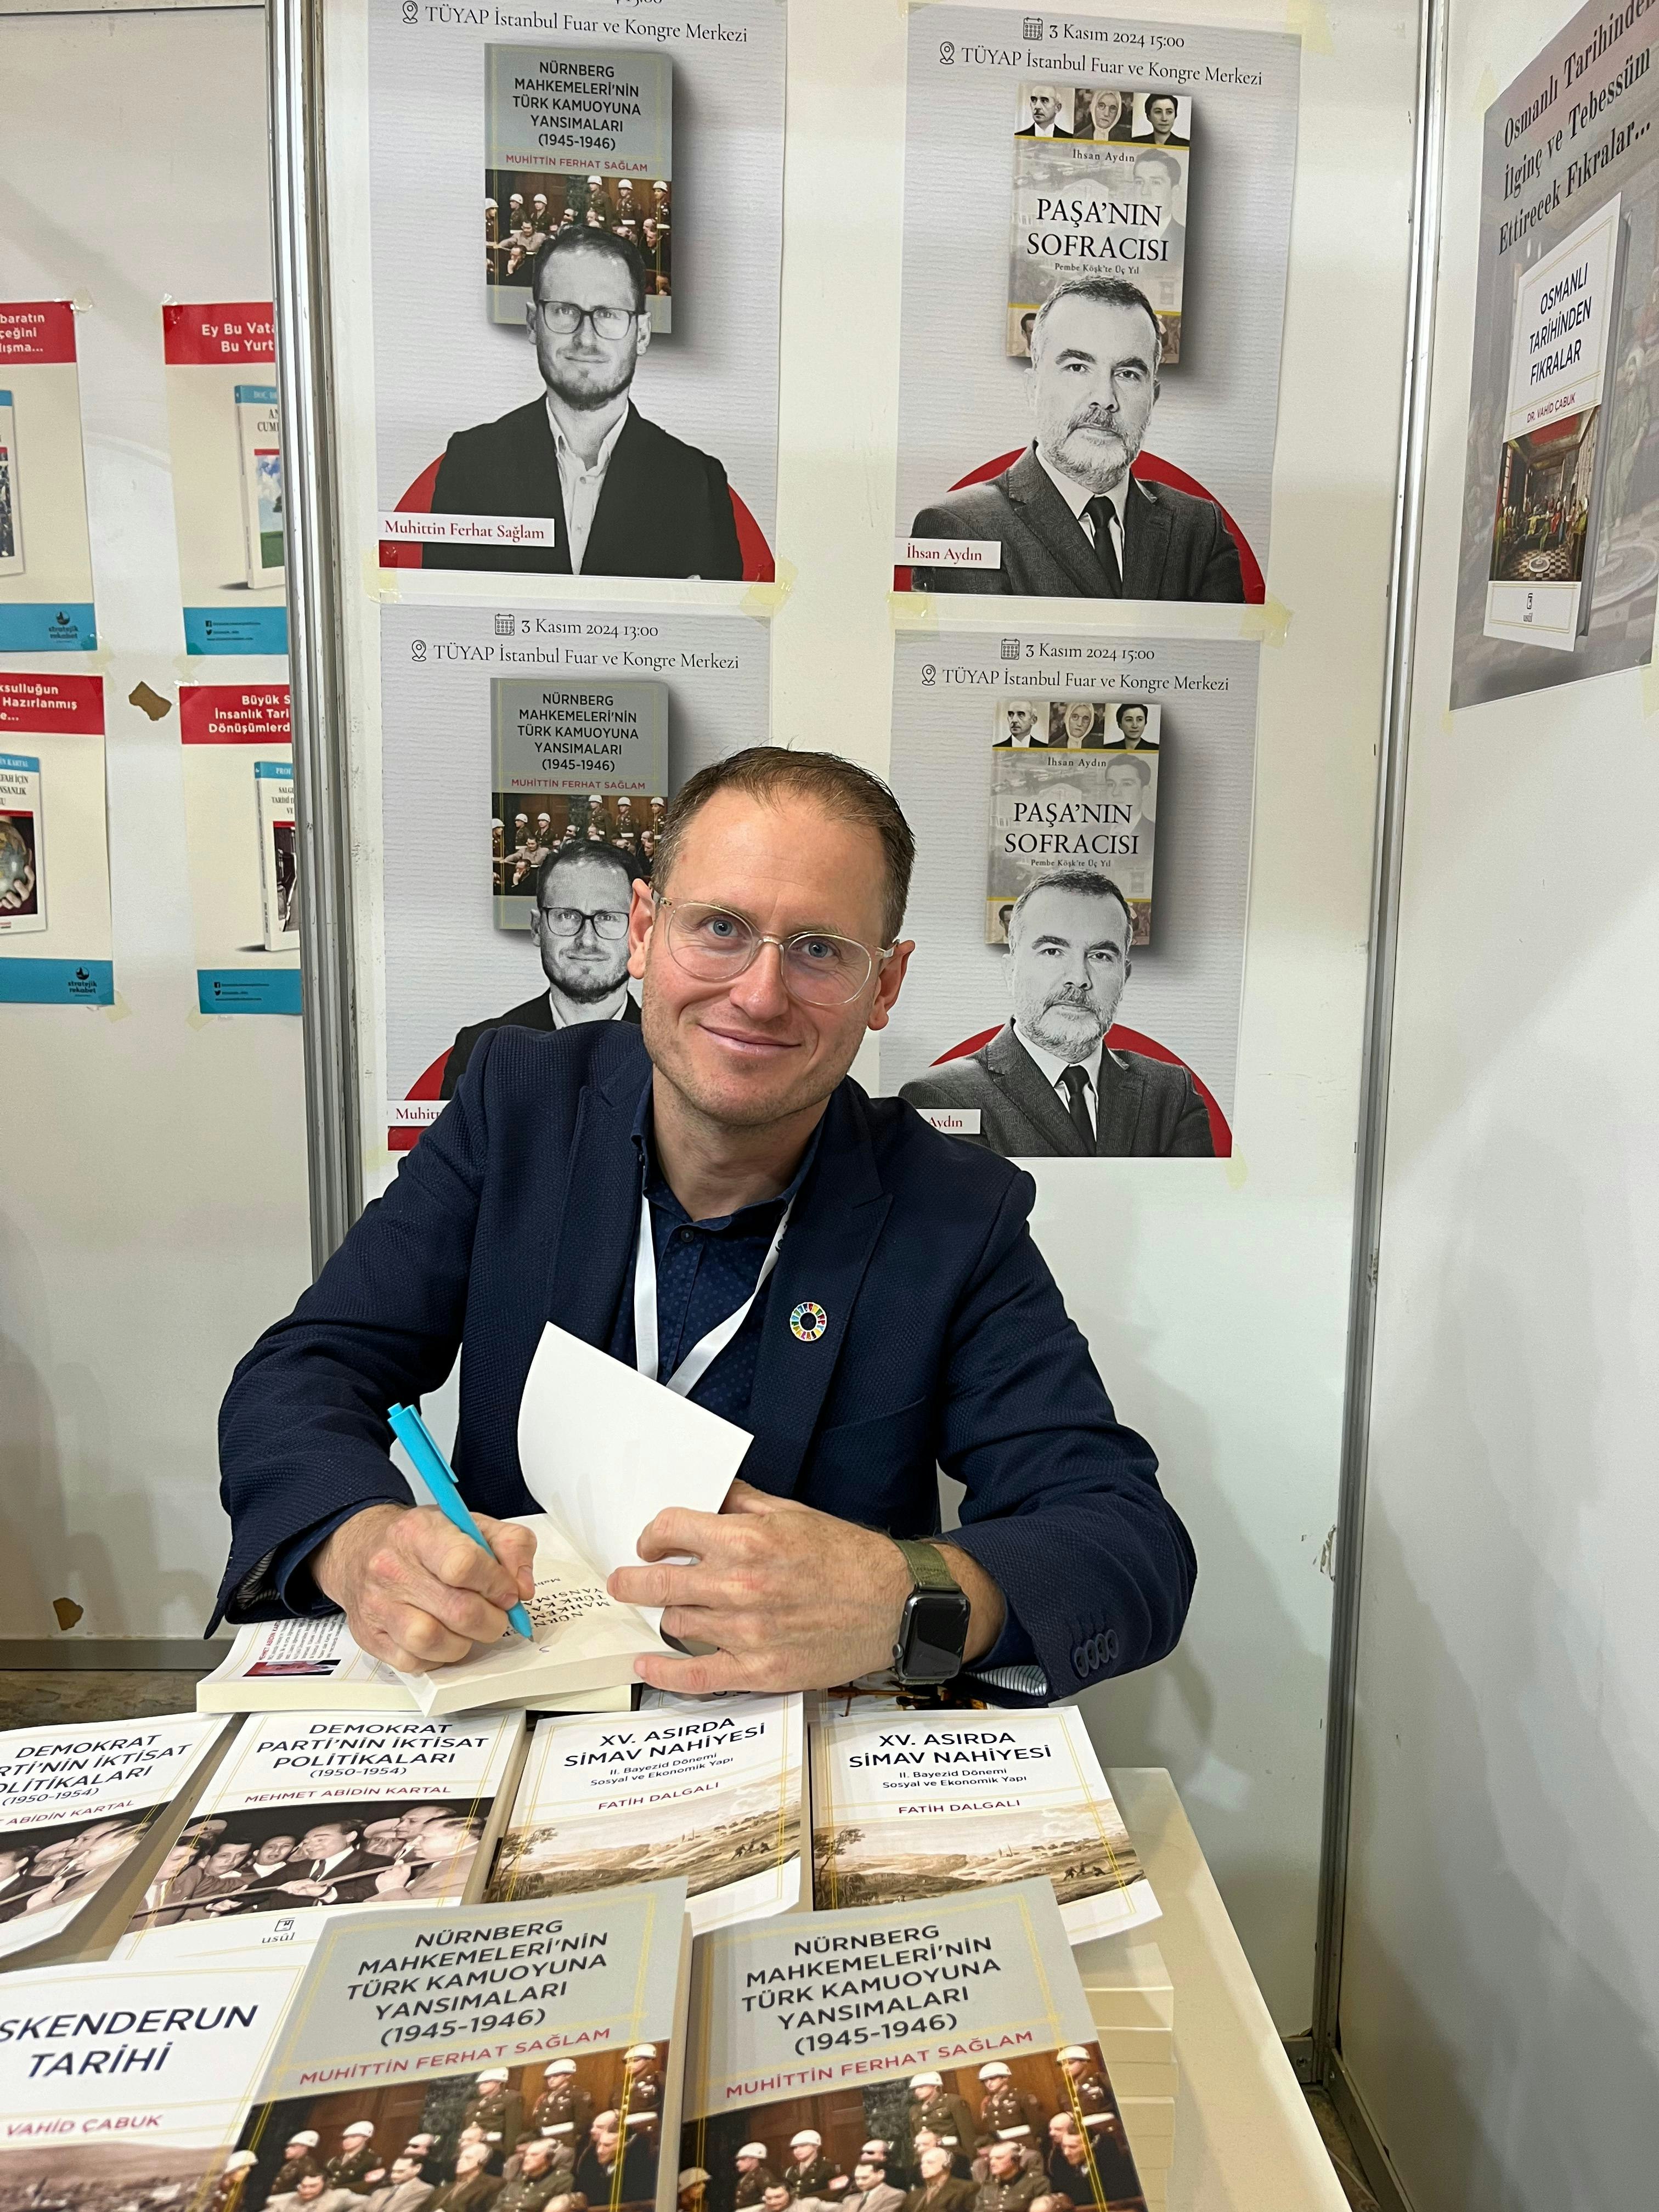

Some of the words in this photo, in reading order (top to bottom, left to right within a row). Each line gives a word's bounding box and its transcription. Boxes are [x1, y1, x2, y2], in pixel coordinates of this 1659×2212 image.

[425, 3, 489, 25] TÜYAP
[495, 8, 557, 29] İstanbul
[564, 15, 596, 32] Fuar
[602, 22, 619, 33] ve
[625, 19, 680, 41] Kongre
[686, 24, 747, 42] Merkezi
[1049, 25, 1058, 38] 3
[1063, 24, 1108, 42] Kasım
[1114, 32, 1144, 47] 2024
[1150, 35, 1184, 49] 15:00
[539, 61, 614, 78] NÜRNBERG
[962, 46, 1021, 66] TÜYAP
[1027, 50, 1085, 71] İstanbul
[1091, 57, 1124, 75] Fuar
[1128, 65, 1143, 76] ve
[1149, 61, 1200, 82] Kongre
[1206, 67, 1262, 86] Merkezi
[512, 94, 549, 110] TÜRK
[552, 98, 641, 115] KAMUOYUNA
[1505, 75, 1559, 148] Osmanlı
[1547, 128, 1562, 159] ve
[1569, 48, 1651, 140] Tebessüm
[531, 115, 623, 132] YANSIMALARI
[538, 133, 616, 151] (1945-1946)
[506, 154, 555, 166] MUHİTTİN
[560, 158, 600, 170] FERHAT
[605, 160, 647, 172] SAĞLAM
[1105, 152, 1135, 163] Aydın
[1499, 178, 1561, 256] Ettirecek
[1027, 233, 1169, 261] SOFRACISI
[1055, 263, 1080, 272] Pembe
[1541, 262, 1588, 315] OSMANLI
[202, 324, 218, 337] Ey
[224, 323, 241, 335] Bu
[1530, 295, 1592, 355] TARİHİNDEN
[221, 341, 239, 352] Bu
[1531, 338, 1582, 386] FIKRALAR
[385, 520, 445, 536] Muhittin
[450, 523, 493, 538] Ferhat
[497, 524, 544, 540] Sağlam
[906, 544, 940, 560] İhsan
[944, 547, 982, 565] Aydın
[522, 619, 531, 633] 3
[535, 618, 582, 635] Kasım
[586, 624, 618, 639] 2024
[623, 624, 658, 640] 13:00
[433, 641, 494, 661] TÜYAP
[499, 646, 560, 663] İstanbul
[566, 650, 599, 665] Fuar
[602, 655, 618, 664] ve
[623, 651, 676, 671] Kongre
[680, 653, 739, 669] Merkezi
[1026, 645, 1034, 658] 3
[1039, 642, 1082, 658] Kasım
[1086, 649, 1117, 662] 2024
[1121, 650, 1154, 664] 15:00
[943, 668, 1000, 685] TÜYAP
[1004, 669, 1060, 686] İstanbul
[1065, 673, 1096, 688] Fuar
[1101, 678, 1115, 689] ve
[1120, 675, 1169, 694] Kongre
[1174, 676, 1229, 691] Merkezi
[3, 697, 77, 710] Hazırlanmış
[242, 695, 280, 706] Büyük
[543, 692, 613, 706] NÜRNBERG
[215, 707, 263, 719] İnsanlık
[208, 723, 290, 735] Dönüşümlerd
[517, 724, 551, 737] TÜRK
[555, 726, 639, 739] KAMUOYUNA
[534, 742, 622, 755] YANSIMALARI
[542, 759, 615, 772] (1945-1946)
[1078, 759, 1107, 768] Aydın
[511, 778, 558, 787] MUHİTTİN
[605, 780, 645, 789] SAĞLAM
[1005, 833, 1139, 854] SOFRACISI
[309, 1724, 452, 1735] DEMOKRAT
[599, 1734, 636, 1747] XV.
[644, 1718, 735, 1741] ASIRDA
[879, 1734, 916, 1747] XV.
[924, 1732, 1015, 1746] ASIRDA
[15, 1734, 162, 1759] DEMOKRAT
[392, 1736, 488, 1748] İKTİSAT
[563, 1751, 642, 1767] SİMAV
[650, 1723, 765, 1757] NAHİYESİ
[93, 1743, 193, 1768] İKTİSAT
[273, 1753, 456, 1769] POLİTİKALARI
[624, 1762, 669, 1775] Bayezid
[673, 1753, 717, 1767] Dönemi
[849, 1752, 924, 1768] SİMAV
[934, 1745, 1052, 1763] NAHİYESİ
[310, 1767, 407, 1778] (1950-1954)
[590, 1776, 628, 1786] Sosyal
[648, 1764, 706, 1779] Ekonomik
[709, 1757, 733, 1768] Yapı
[883, 1780, 920, 1789] Sosyal
[941, 1776, 998, 1786] Ekonomik
[1002, 1775, 1027, 1784] Yapı
[913, 1769, 959, 1780] Bayezid
[962, 1768, 1007, 1777] Dönemi
[2, 1788, 99, 1806] (1950-1954)
[245, 1791, 317, 1803] MEHMET
[321, 1787, 380, 1796] ABİDİN
[386, 1786, 452, 1794] KARTAL
[599, 1797, 643, 1809] FATİH
[650, 1782, 719, 1802] DALGALI
[6, 1812, 65, 1825] ABİDİN
[71, 1801, 135, 1816] KARTAL
[899, 1803, 944, 1814] FATİH
[950, 1799, 1020, 1812] DALGALI
[262, 1933, 295, 1944] usûl
[415, 1920, 563, 1948] NÜRNBERG
[794, 1925, 939, 1956] NÜRNBERG
[347, 1980, 417, 2000] TÜRK
[426, 1954, 607, 1991] KAMUOYUNA
[742, 1985, 813, 2012] TÜRK
[822, 1957, 1001, 1999] KAMUOYUNA
[375, 1981, 567, 2021] YANSIMALARI
[778, 1986, 969, 2030] YANSIMALARI
[381, 2007, 545, 2047] (1945-1946)
[795, 2012, 957, 2056] (1945-1946)
[28, 2042, 173, 2079] TARİHİ
[300, 2059, 409, 2085] MUHİTTİN
[416, 2045, 509, 2068] FERHAT
[515, 2028, 610, 2055] SAĞLAM
[726, 2067, 833, 2099] MUHİTTİN
[841, 2050, 930, 2076] FERHAT
[938, 2031, 1033, 2058] SAĞLAM
[7, 2118, 75, 2138] VAHİD
[82, 2114, 163, 2133] ÇABUK
